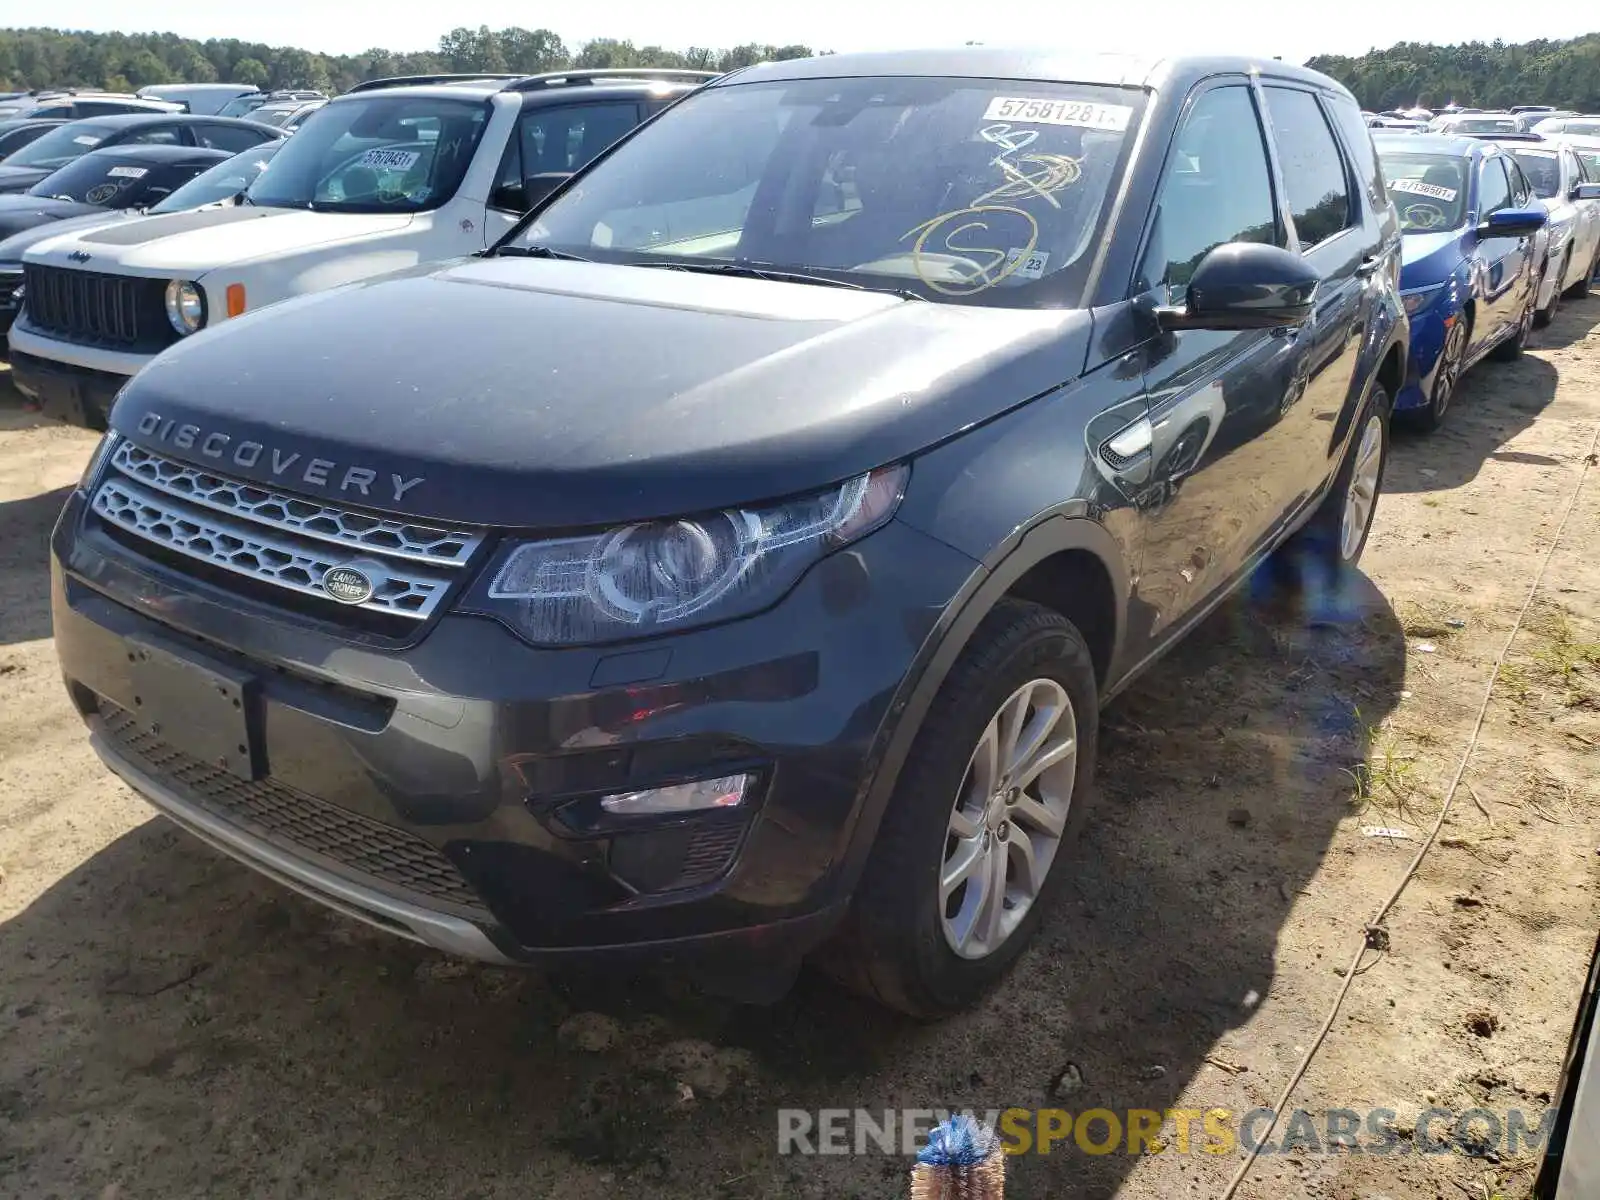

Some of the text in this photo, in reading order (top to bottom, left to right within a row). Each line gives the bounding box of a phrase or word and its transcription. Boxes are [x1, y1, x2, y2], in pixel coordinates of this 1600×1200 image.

[136, 411, 426, 501] DISCOVERY
[332, 571, 357, 585] LAND
[332, 582, 363, 596] ROVER
